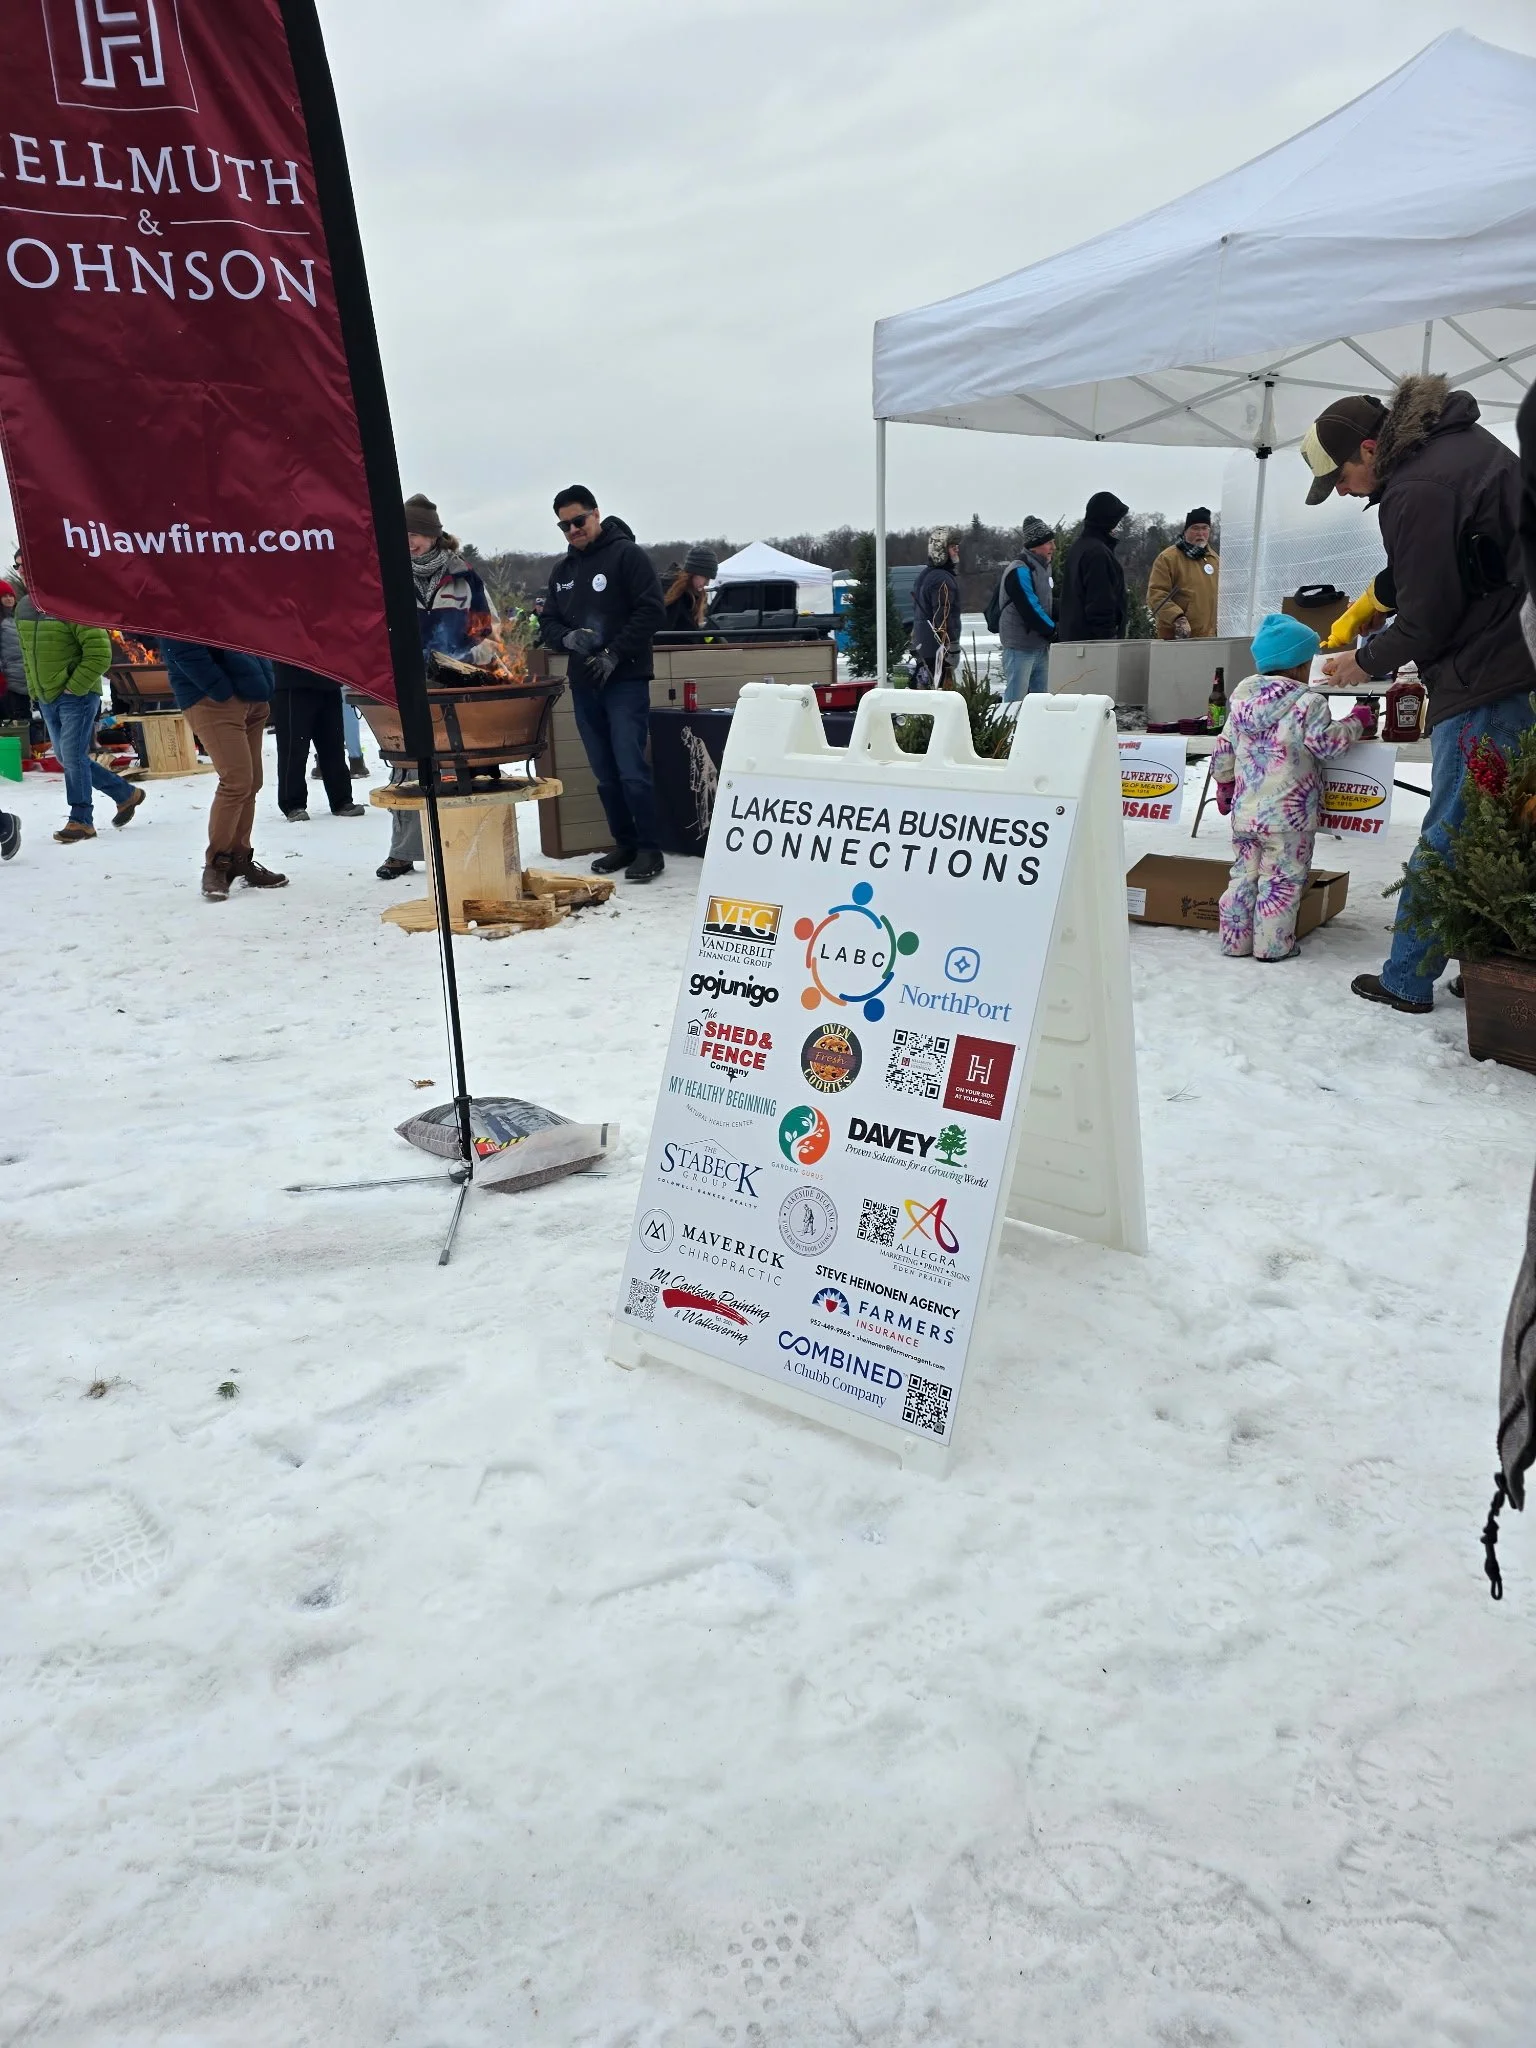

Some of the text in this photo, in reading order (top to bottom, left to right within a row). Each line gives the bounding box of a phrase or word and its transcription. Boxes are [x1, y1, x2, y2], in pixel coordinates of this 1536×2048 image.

[0, 133, 304, 205] ELLMUTH
[137, 208, 163, 236] &
[7, 238, 316, 307] OHNSON
[63, 518, 335, 558] hjlawfirm.com
[1118, 741, 1142, 750] erving
[1121, 770, 1173, 783] LLWERTH'S
[731, 795, 1050, 848] LAKES AREA BUSINESS
[1122, 801, 1173, 820] USAGE
[725, 826, 1041, 886] CONNECTIONS
[714, 902, 774, 937] VFG
[698, 949, 773, 969] FINANCIAL GROUP
[701, 936, 775, 959] VANDERBILT
[820, 943, 886, 968] LABC
[688, 969, 779, 1007] gojunigo
[899, 983, 1012, 1022] NorthPort
[701, 1008, 718, 1020] The
[822, 1023, 852, 1039] OVEN
[700, 1040, 767, 1070] FENCE
[710, 1061, 749, 1077] Company
[815, 1051, 847, 1065] Fresh
[668, 1075, 777, 1117] MY HEALTHY BEGINNING
[803, 1068, 852, 1093] COOKIES
[686, 1103, 754, 1128] NATURAL HEALTH CENTER
[963, 1095, 978, 1103] YOUR
[704, 1145, 717, 1155] THE
[847, 1117, 937, 1158] DAVEY
[660, 1142, 763, 1198] STABECK
[682, 1170, 727, 1188] GROUP
[771, 1161, 824, 1180] GARDEN GURUS
[845, 1143, 871, 1157] Proven
[872, 1150, 907, 1167] Solutions
[906, 1159, 920, 1171] for
[927, 1165, 964, 1184] Growing
[963, 1173, 989, 1188] World
[657, 1177, 758, 1209] COLDWELL BANKER REALTY
[784, 1189, 835, 1222] LAKESIDE DECKING
[682, 1223, 785, 1270] MAVERICK
[896, 1243, 956, 1268] ALLEGRA
[678, 1244, 783, 1287] CHIROPRACTIC
[880, 1248, 971, 1282] MARKETING PRINT SIGNS
[893, 1264, 952, 1287] EDEN PRAIRIE
[649, 1267, 771, 1323] M. Carlson Painting
[815, 1264, 961, 1320] STEVE HEINONEN AGENCY
[674, 1309, 749, 1346] & Wallcovering
[856, 1319, 920, 1348] INSURANCE
[858, 1300, 955, 1344] FARMERS
[778, 1330, 903, 1389] COMBINED
[856, 1336, 946, 1371] sheinonen@farmersagent.com
[783, 1359, 887, 1409] A Chubb Company
